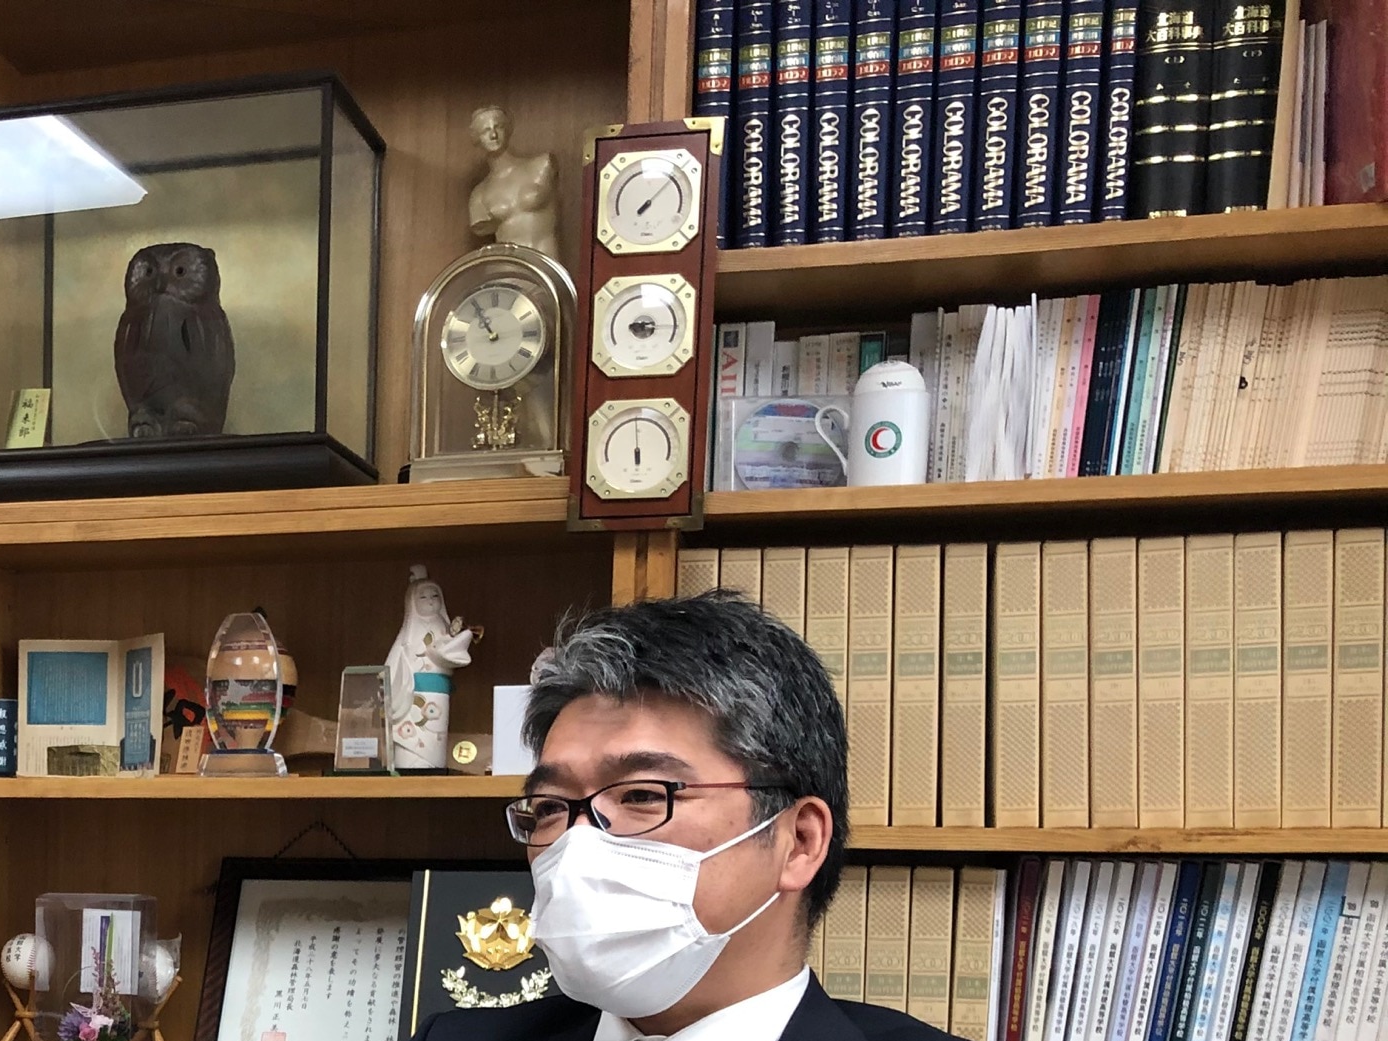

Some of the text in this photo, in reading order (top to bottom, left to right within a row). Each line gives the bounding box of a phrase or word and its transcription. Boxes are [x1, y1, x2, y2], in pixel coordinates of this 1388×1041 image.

[743, 118, 763, 228] COLORAMA
[779, 113, 800, 224] COLORAMA
[818, 112, 839, 222] COLORAMA
[857, 108, 880, 220] COLORAMA
[900, 104, 923, 218] COLORAMA
[940, 101, 965, 215] COLORAMA
[982, 96, 1007, 211] COLORAMA
[1025, 93, 1050, 207] COLORAMA
[1065, 90, 1092, 204] COLORAMA
[1105, 87, 1130, 200] COLORAMA
